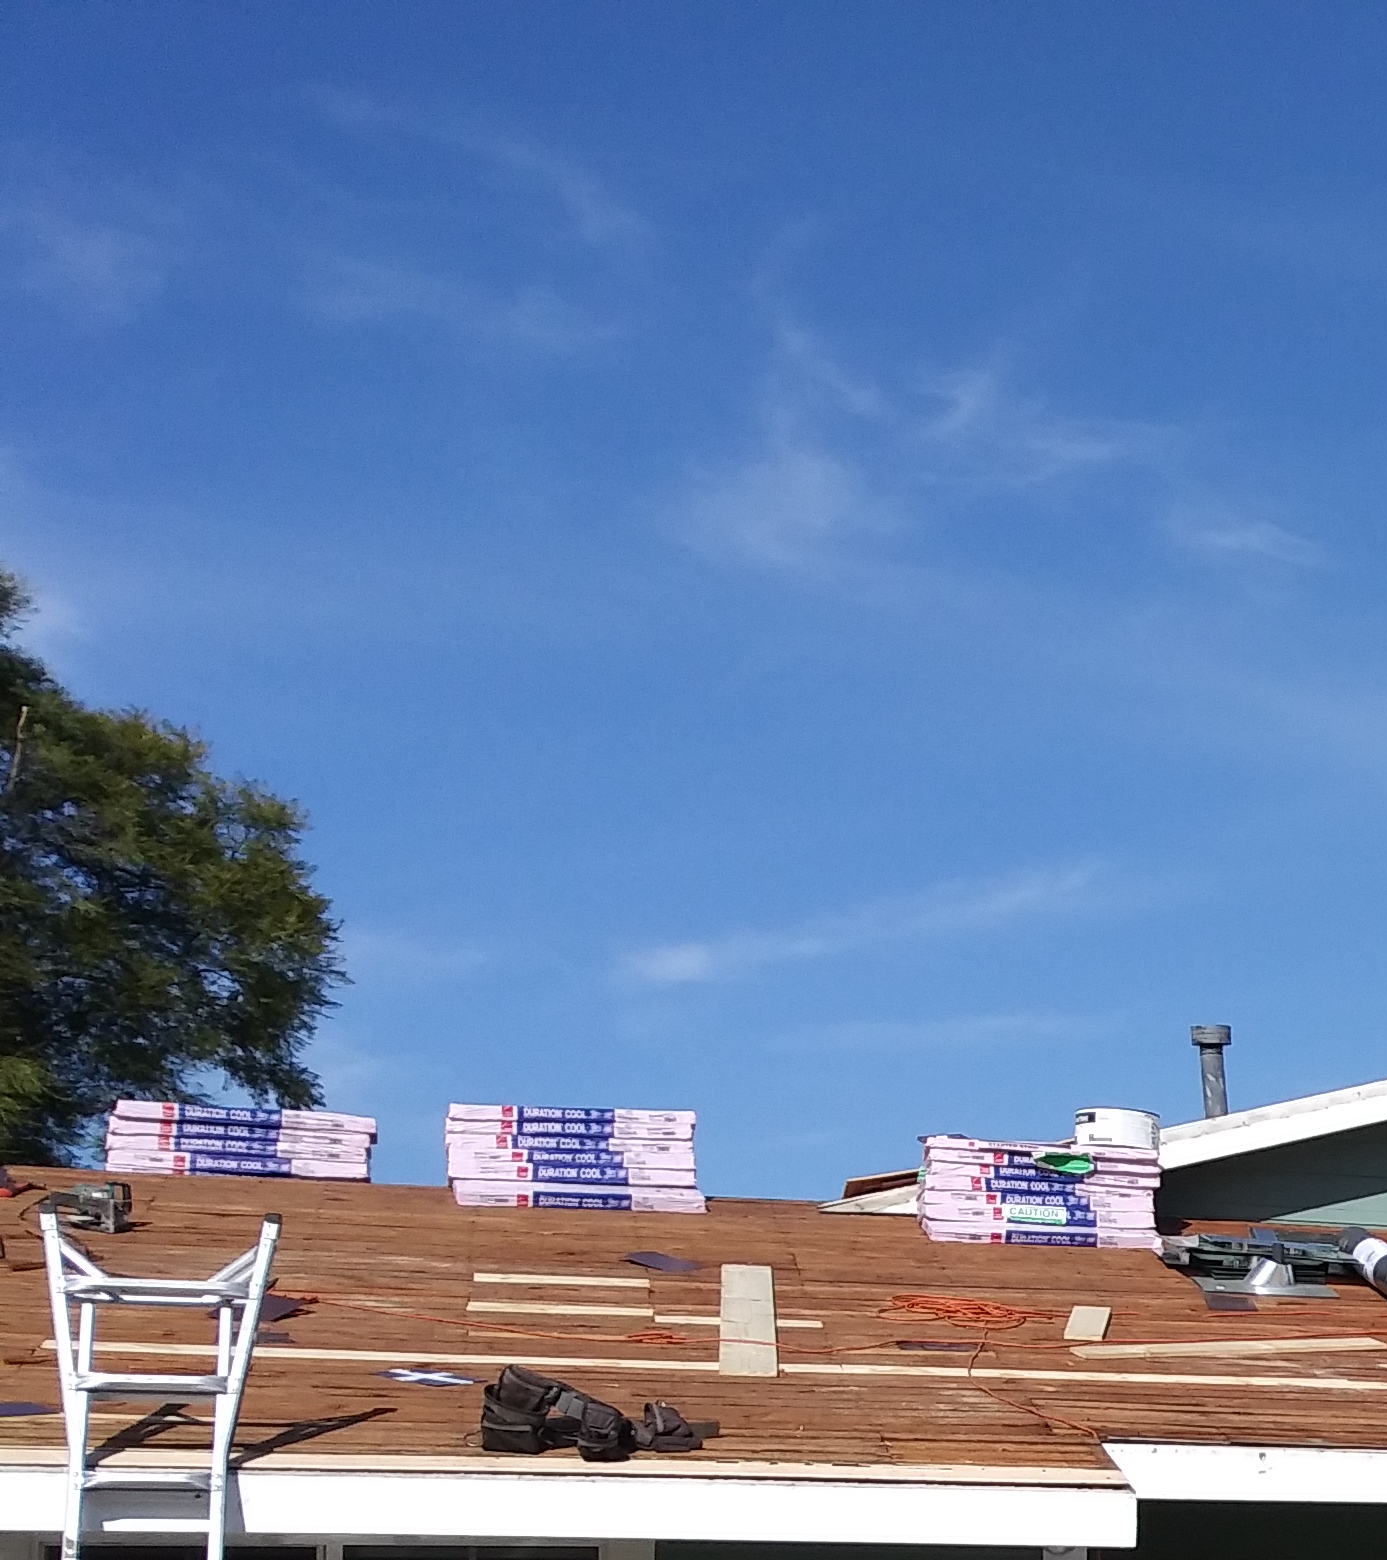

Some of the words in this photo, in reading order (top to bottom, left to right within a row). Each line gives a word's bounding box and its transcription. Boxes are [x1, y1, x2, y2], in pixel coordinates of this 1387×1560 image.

[523, 1107, 562, 1119] DURATION
[565, 1109, 587, 1120] COOL
[522, 1121, 562, 1133] DURATION
[564, 1123, 587, 1134] COOL
[517, 1136, 557, 1148] DURATION
[559, 1138, 581, 1149] COOL
[538, 1166, 577, 1178] DURATION
[580, 1168, 602, 1179] COOL
[991, 1179, 1028, 1190] DURATION
[1030, 1181, 1051, 1191] COOL
[1006, 1193, 1043, 1204] DURATION
[1045, 1194, 1065, 1206] COOL
[1009, 1207, 1059, 1218] CAUTION
